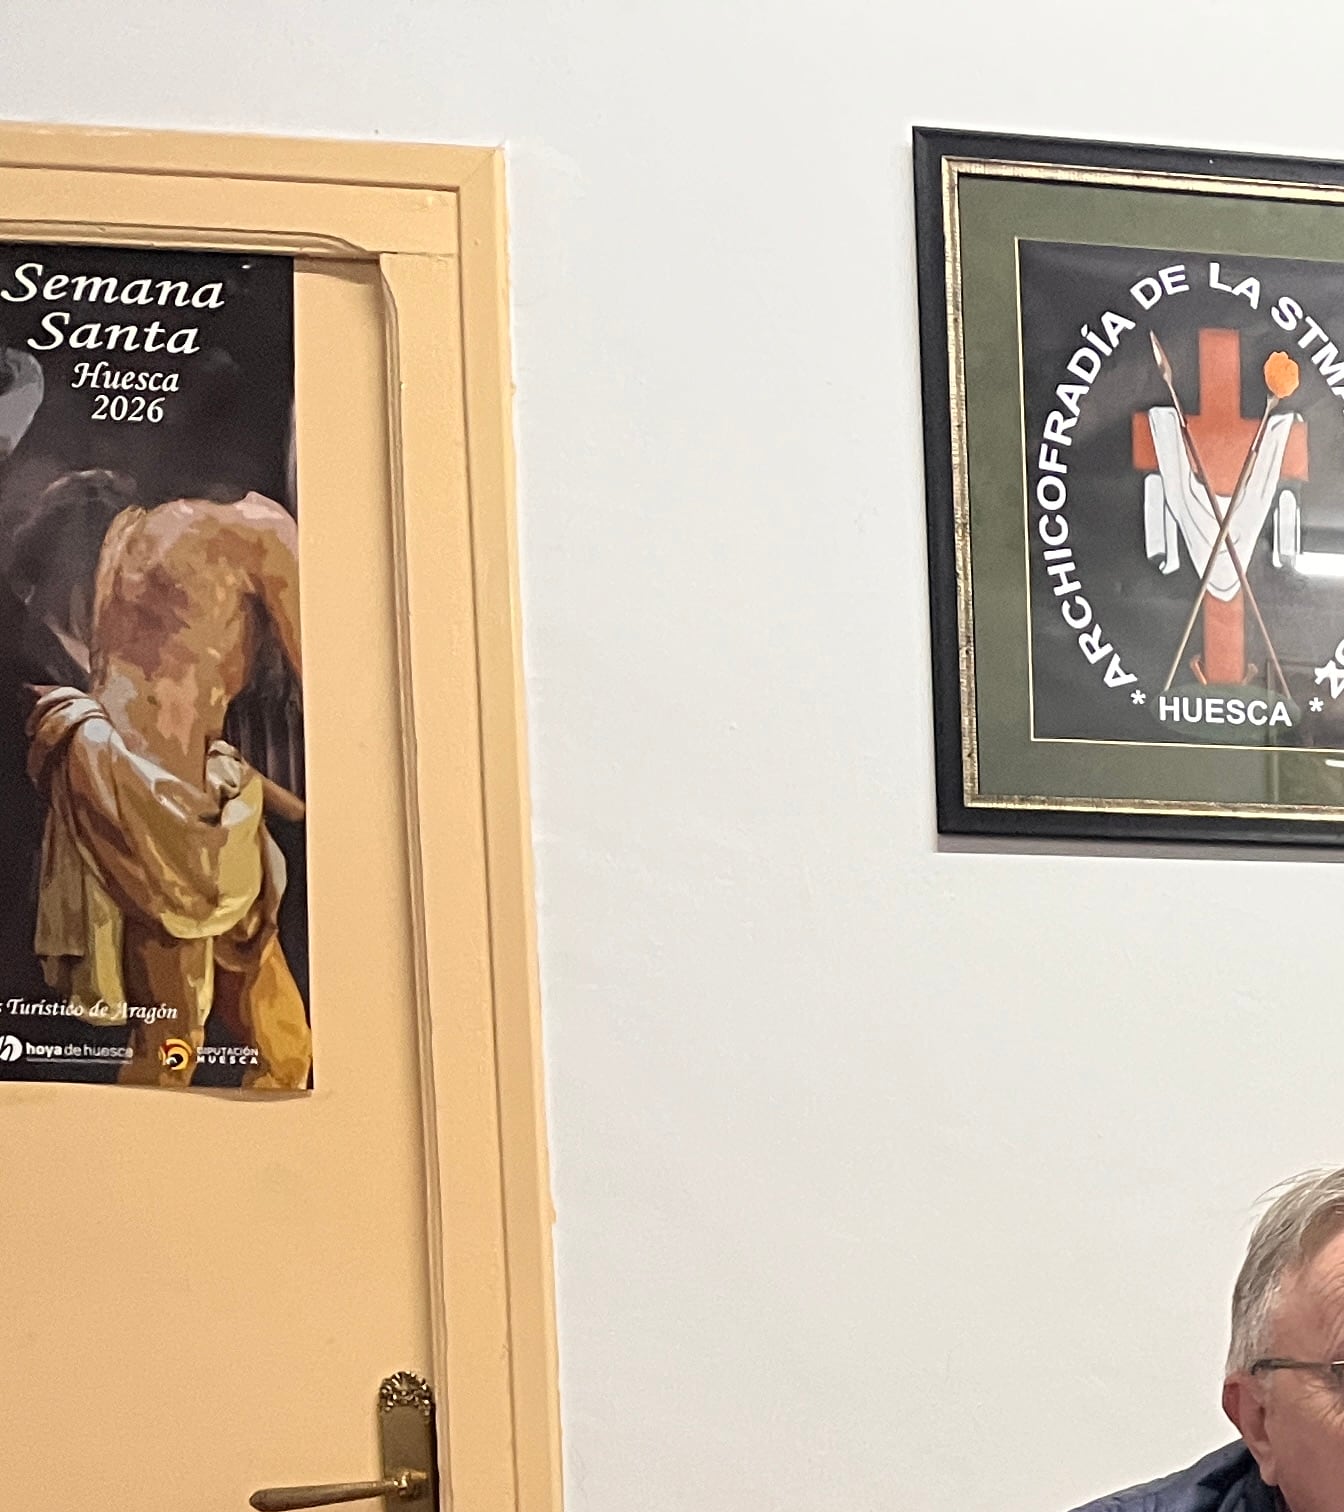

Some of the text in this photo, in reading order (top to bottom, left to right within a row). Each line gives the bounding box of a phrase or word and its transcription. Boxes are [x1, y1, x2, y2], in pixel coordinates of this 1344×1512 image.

[1, 263, 225, 309] Semana
[27, 312, 200, 354] Santa
[71, 361, 180, 392] Huesca
[91, 395, 166, 423] 2026
[1036, 311, 1137, 690] ARCHICOFRADÍA
[1129, 264, 1190, 311] DE
[1208, 261, 1261, 309] LA
[1159, 697, 1292, 726] HUESCA
[6, 997, 177, 1024] Turístico de Aragón
